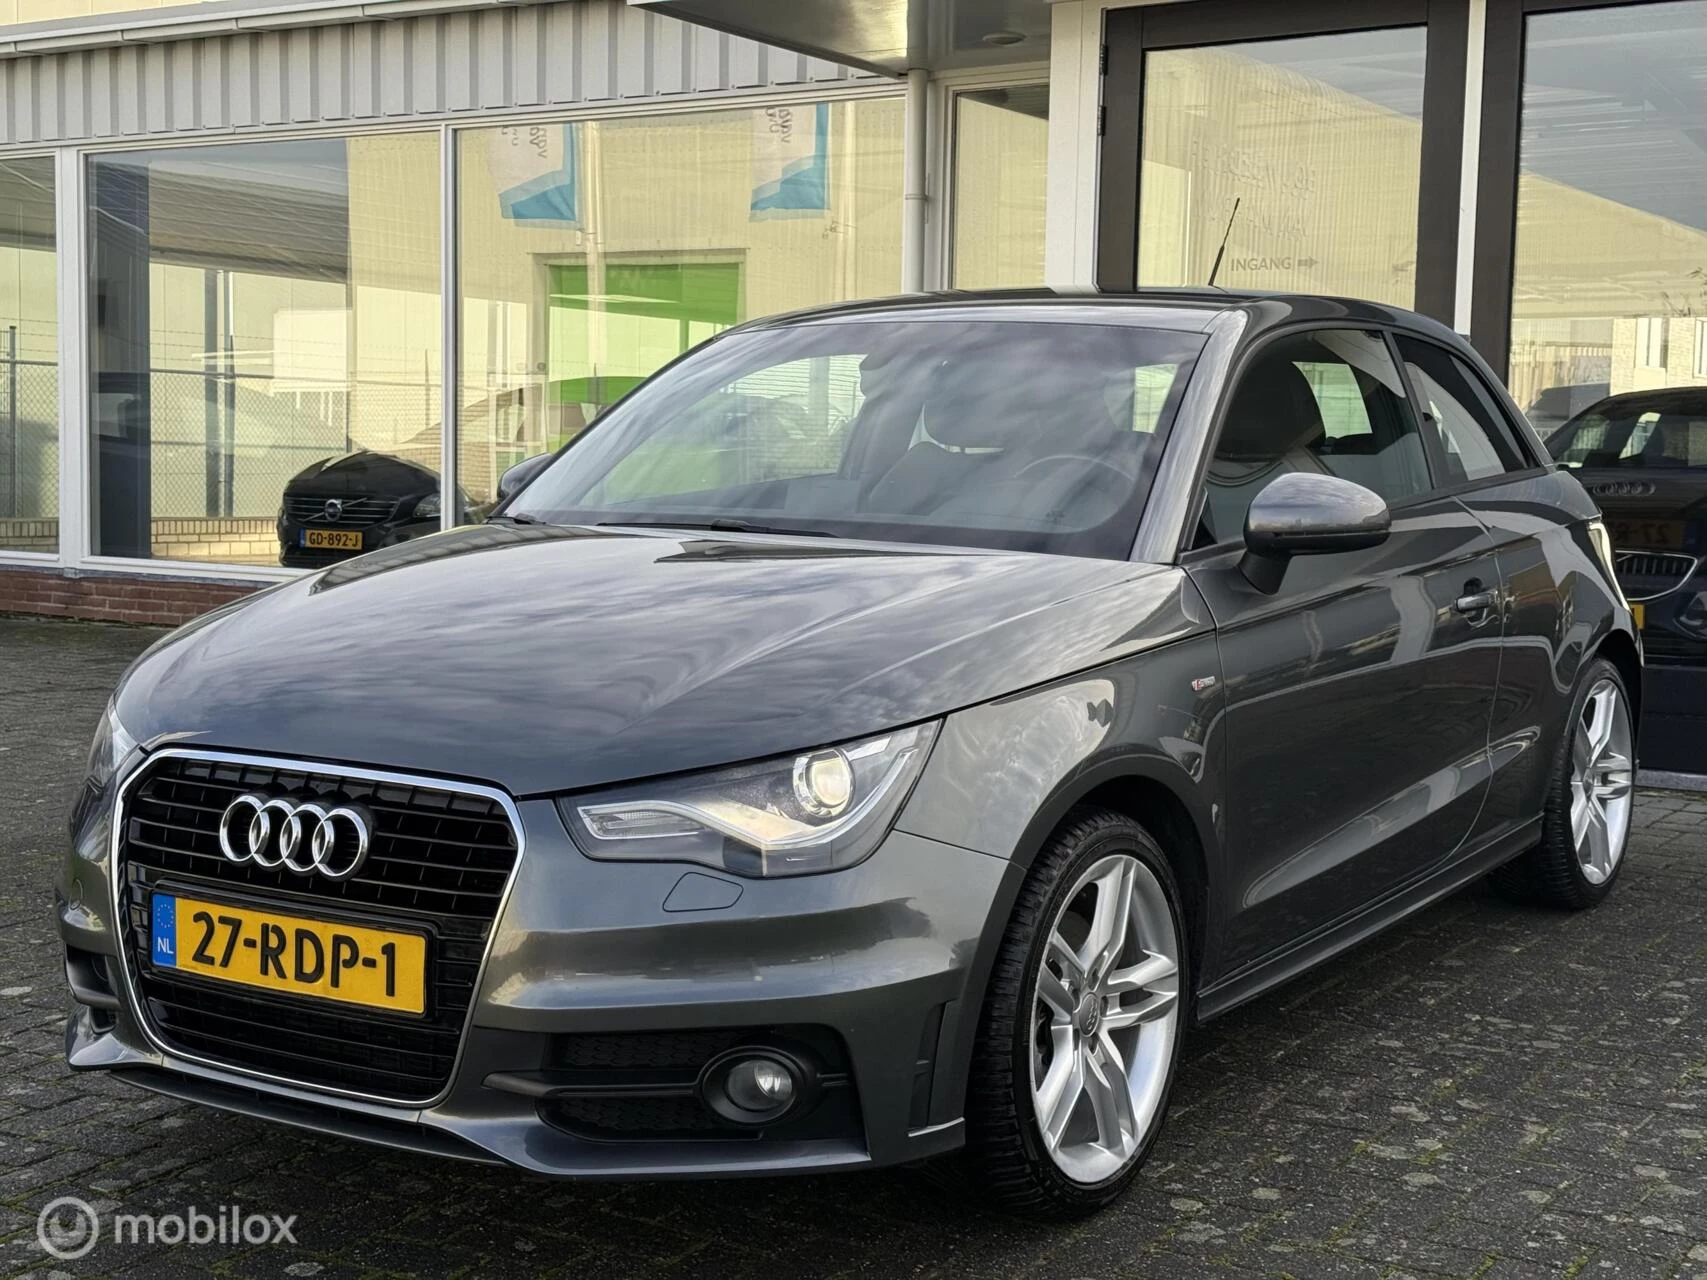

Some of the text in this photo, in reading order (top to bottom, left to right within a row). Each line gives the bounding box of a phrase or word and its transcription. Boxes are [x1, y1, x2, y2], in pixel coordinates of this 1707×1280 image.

[1231, 256, 1292, 272] INGANG
[308, 531, 359, 548] GD-892-J
[157, 936, 175, 955] NL
[191, 911, 396, 998] 27-RDP-1
